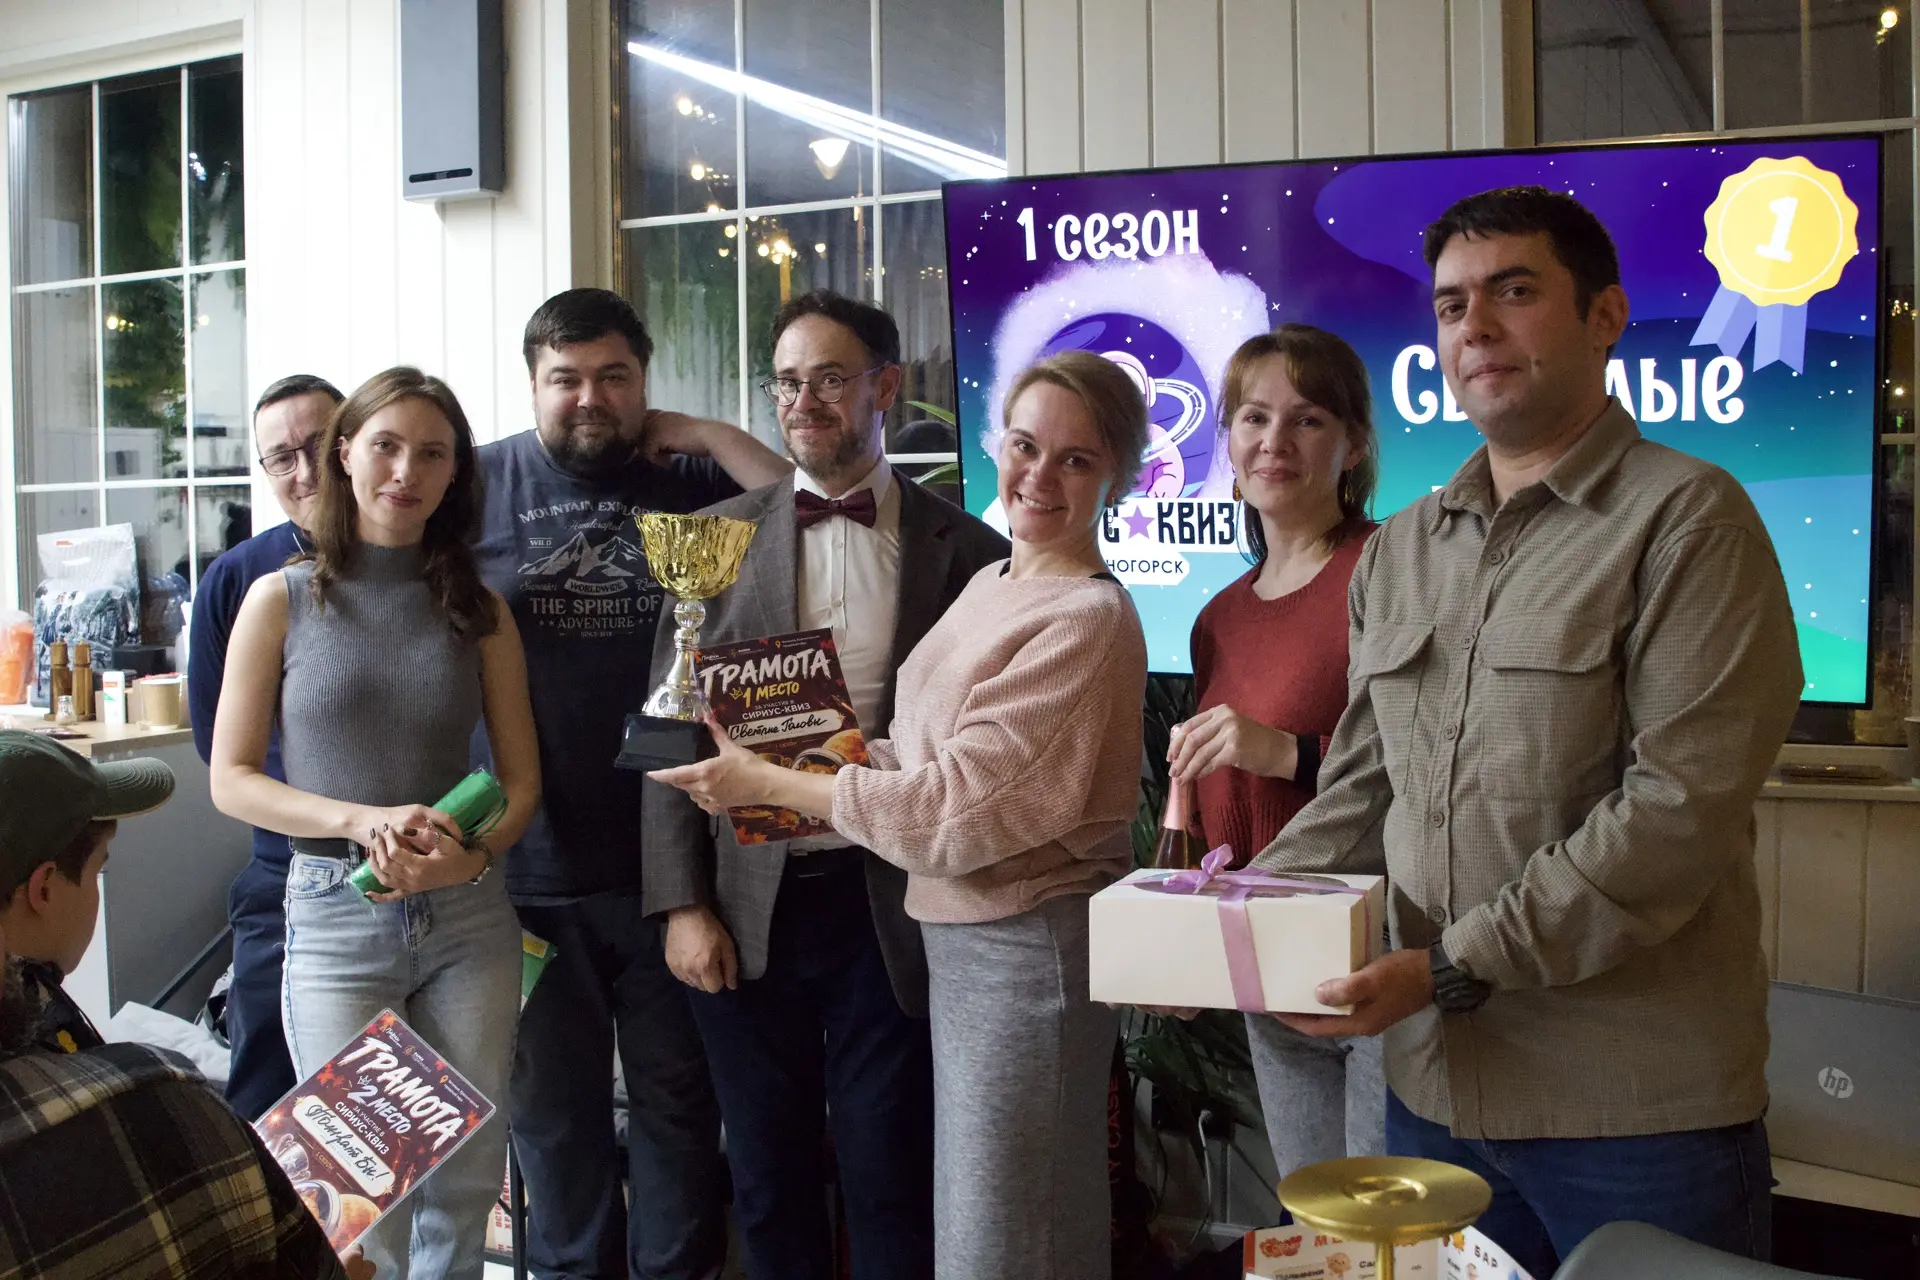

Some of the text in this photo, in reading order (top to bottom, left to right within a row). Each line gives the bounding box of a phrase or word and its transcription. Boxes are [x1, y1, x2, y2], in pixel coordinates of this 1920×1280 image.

[1016, 207, 1037, 261] 1
[1755, 195, 1799, 263] 1
[518, 500, 594, 524] MOUNTAIN
[1157, 502, 1235, 545] КВИЗ
[530, 539, 552, 547] WILD
[529, 594, 662, 616] THE SPIRIT OF
[557, 616, 635, 630] ADVENTURE
[742, 680, 800, 709] 1 МЕСТО
[741, 702, 811, 721] СИРИУС-КВИЗ
[1823, 1064, 1850, 1098] hp
[346, 1084, 413, 1135] 2 МЕСТО
[334, 1100, 390, 1156] СИРИУС-КВИЗ
